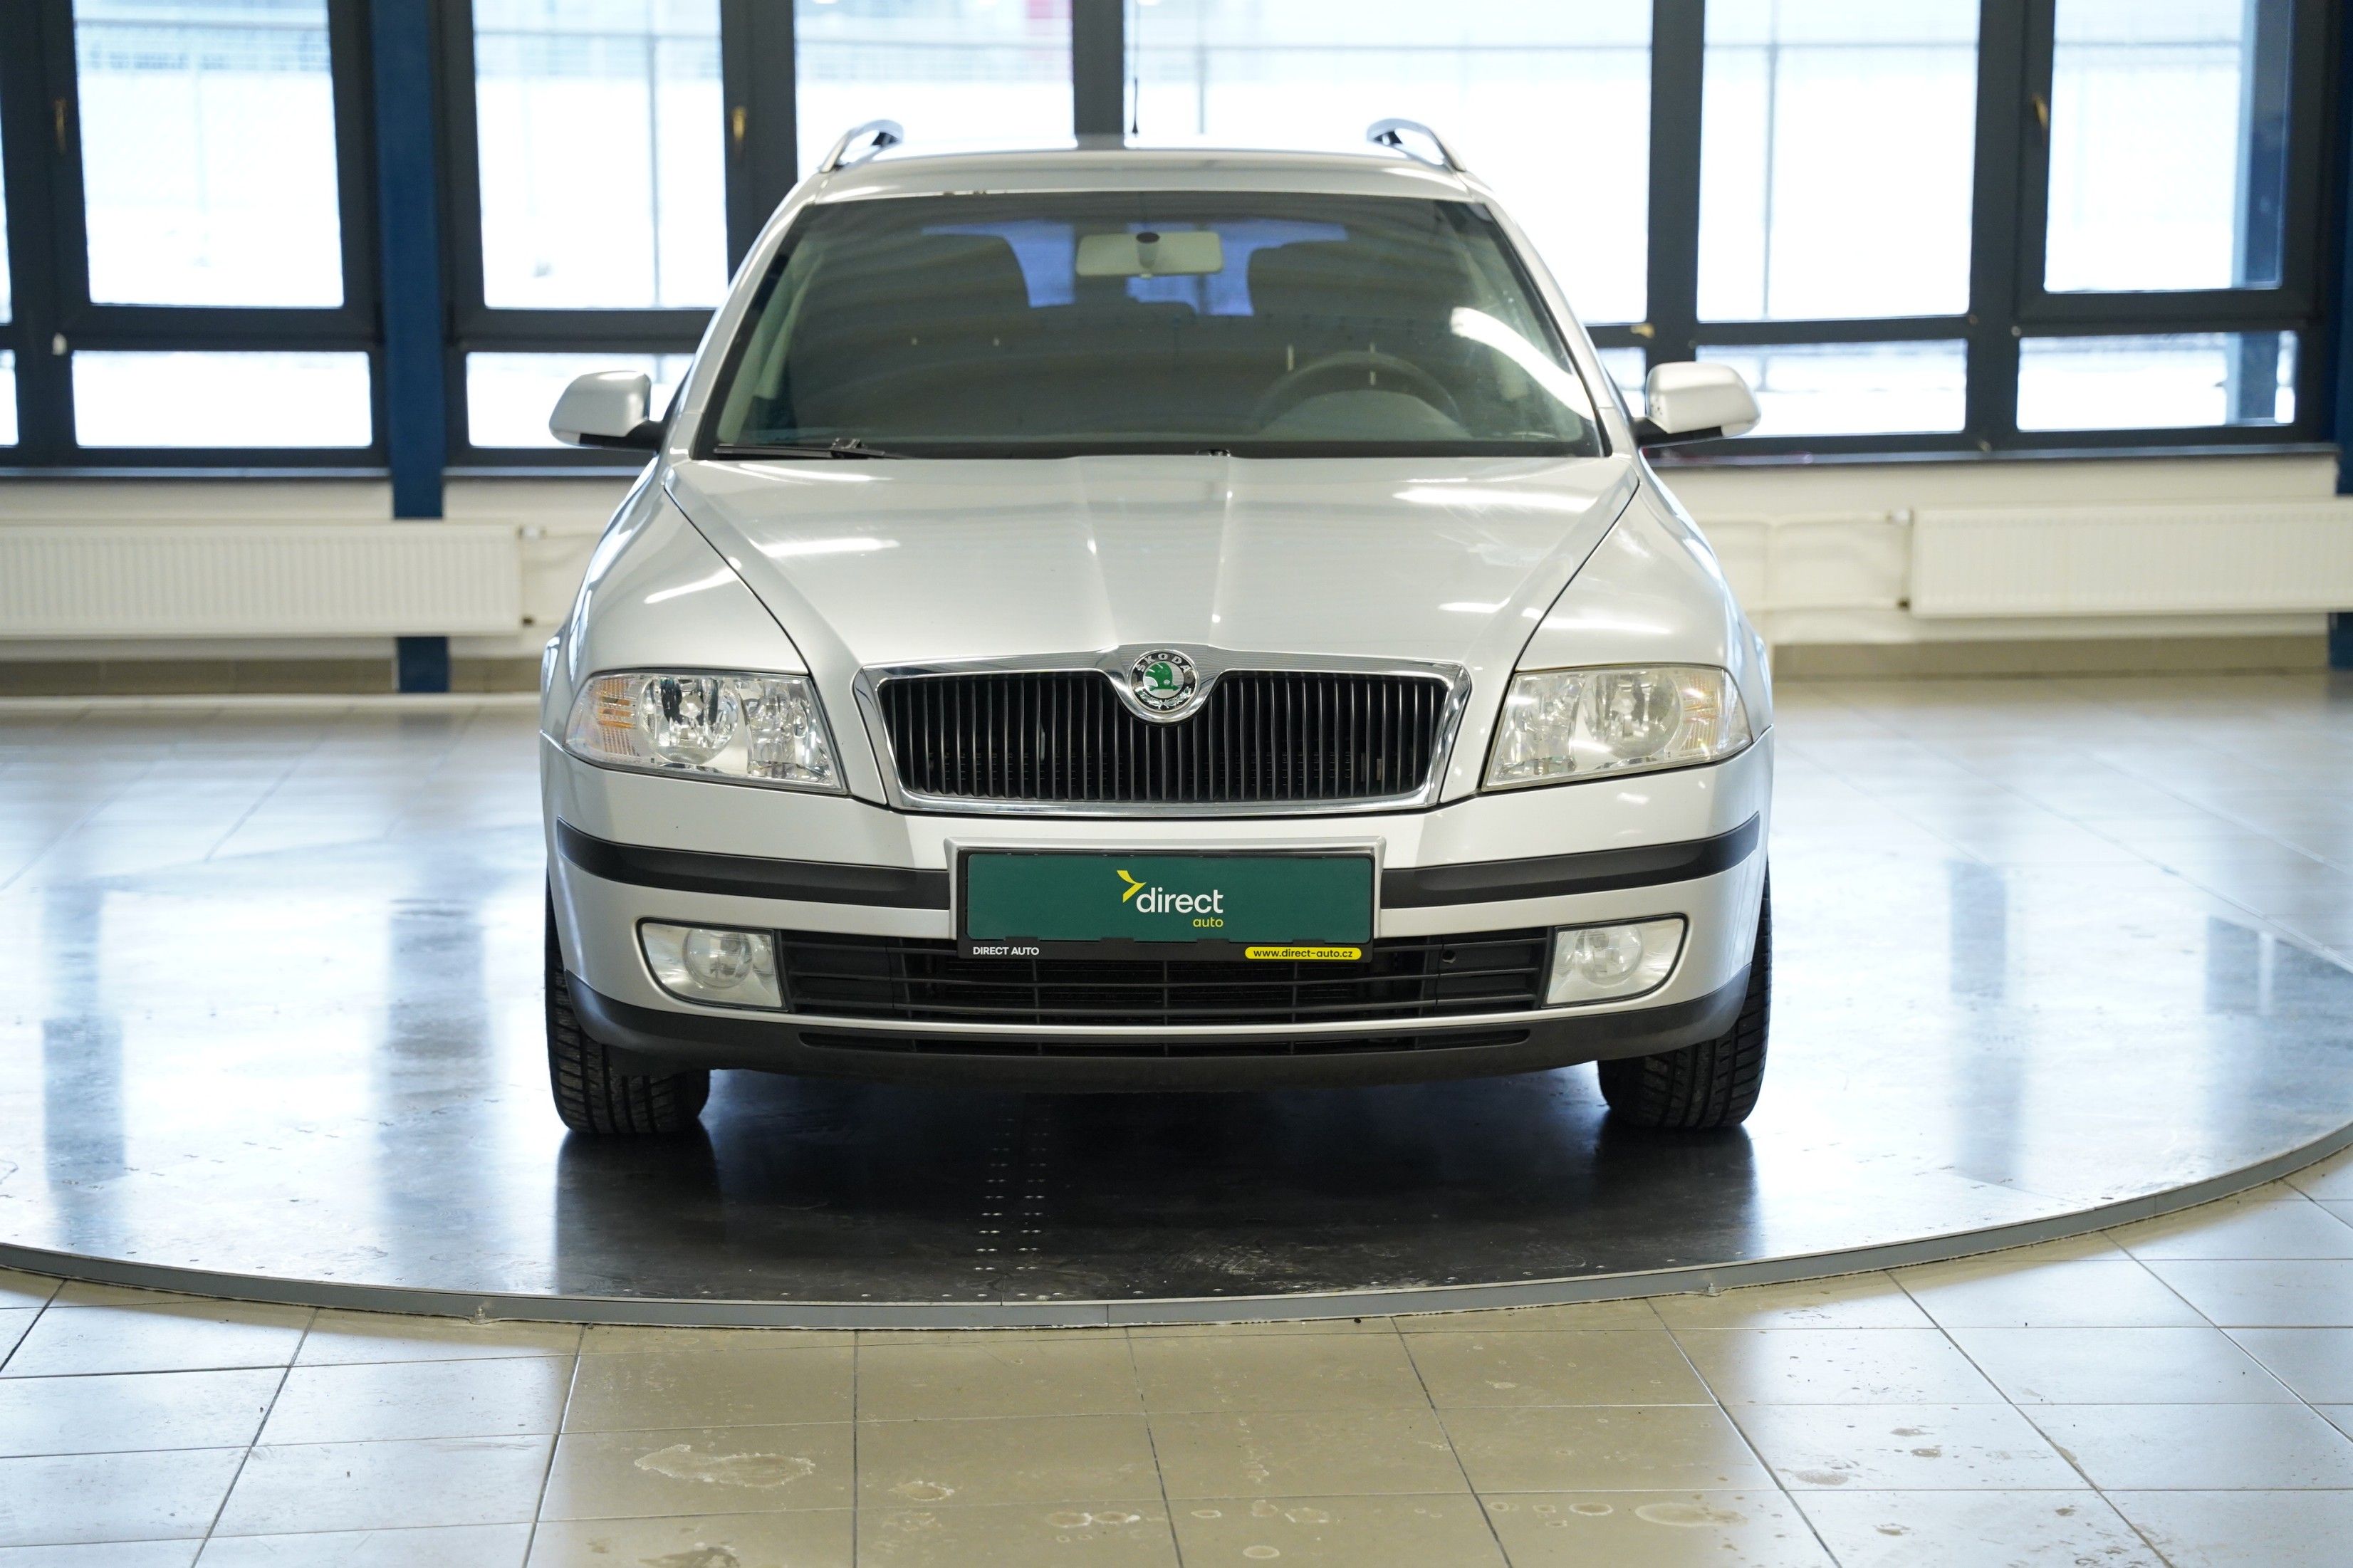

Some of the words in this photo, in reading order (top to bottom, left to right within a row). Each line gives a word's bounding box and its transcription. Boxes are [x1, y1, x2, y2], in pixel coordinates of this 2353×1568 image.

[1136, 887, 1224, 914] direct
[1193, 917, 1224, 928] auto
[973, 946, 1009, 955] DIRECT
[1011, 946, 1040, 955] AUTO
[1253, 948, 1353, 958] www.direct-auto.cz
